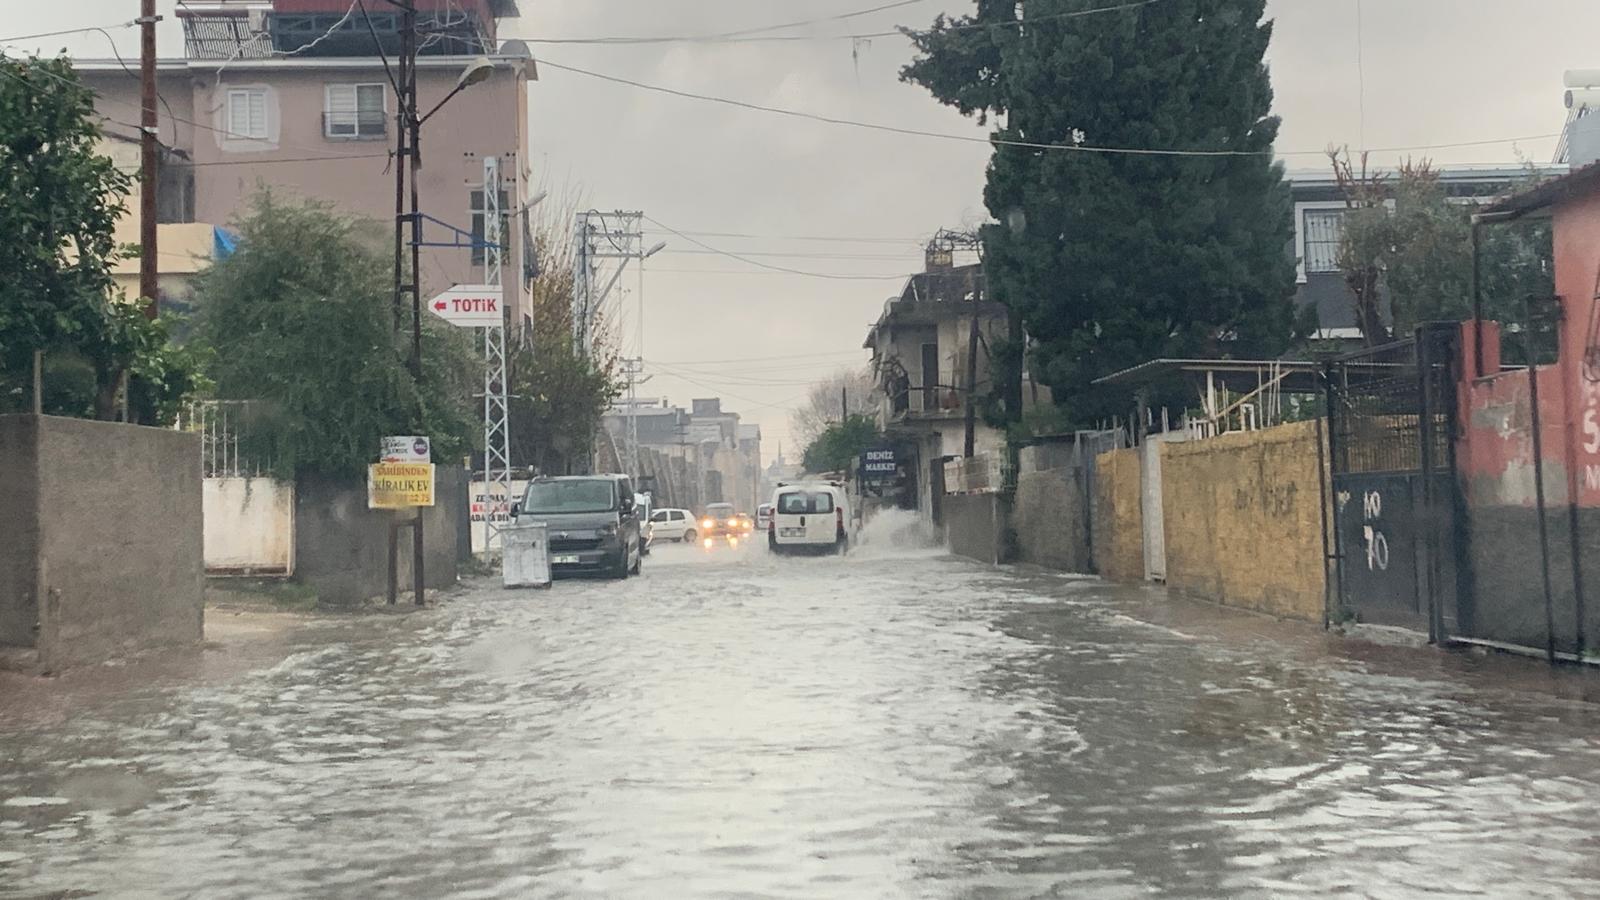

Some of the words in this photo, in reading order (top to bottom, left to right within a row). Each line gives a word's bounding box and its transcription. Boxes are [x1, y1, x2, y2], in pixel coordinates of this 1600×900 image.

[867, 450, 894, 460] DENİZ
[866, 463, 896, 471] MARKET
[374, 478, 415, 492] KİRALIK
[417, 479, 430, 492] EV
